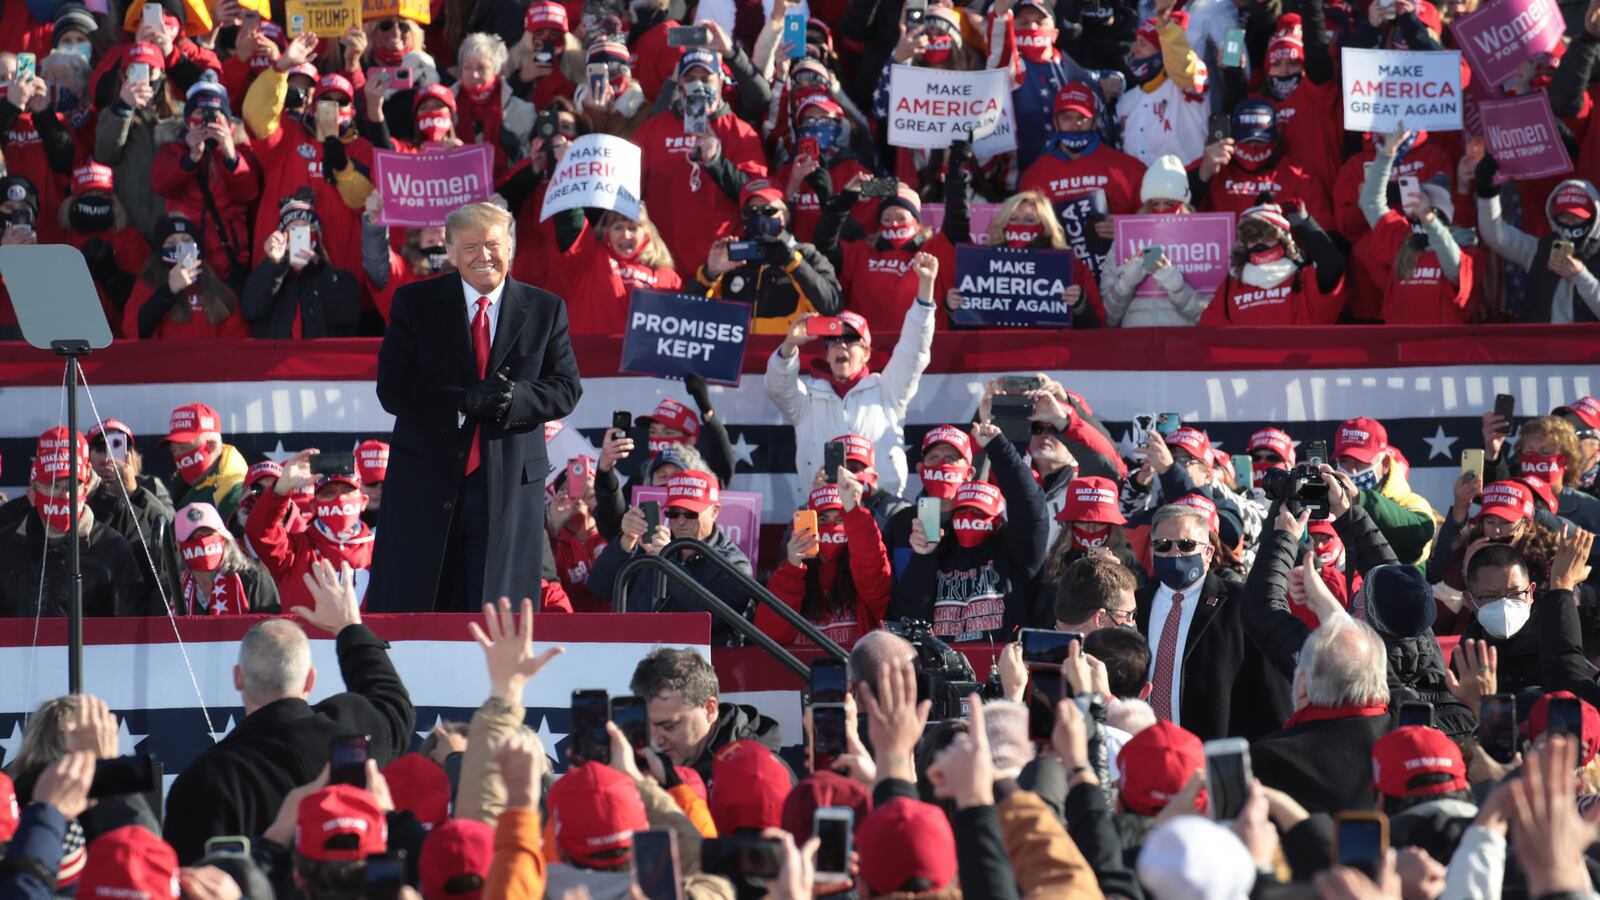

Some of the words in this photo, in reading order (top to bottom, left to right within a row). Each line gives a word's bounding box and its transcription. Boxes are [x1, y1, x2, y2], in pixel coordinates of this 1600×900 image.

[1473, 0, 1551, 55] Women
[925, 39, 951, 50] AGA
[1495, 43, 1520, 60] FOR
[1378, 65, 1423, 78] MAKE
[926, 83, 973, 97] MAKE
[1351, 80, 1456, 99] AMERICA
[896, 97, 998, 117] AMERICA
[1351, 101, 1399, 117] GREAT
[1405, 102, 1457, 117] AGAIN
[895, 118, 947, 134] GREAT
[951, 117, 996, 133] AGAIN
[8, 131, 39, 142] RUM
[665, 136, 698, 148] TRU
[1487, 122, 1549, 151] Women
[570, 147, 612, 161] MAKE
[1498, 150, 1516, 161] FOR
[1517, 144, 1547, 159] TRUMP
[386, 166, 479, 199] Women
[1050, 176, 1108, 191] TRUMP
[401, 195, 425, 206] FOR
[430, 193, 472, 207] TRUMP
[79, 203, 111, 216] TRUMP
[1129, 238, 1221, 262] Wmen
[868, 258, 915, 272] TRUM
[990, 260, 1036, 274] MAKE
[1177, 263, 1212, 273] RUMP
[960, 276, 1065, 296] AMERICA
[1233, 286, 1292, 305] TRUMP
[961, 298, 1012, 311] GREAT
[1015, 300, 1068, 314] AGAIN
[631, 312, 745, 344] PROMISES
[656, 338, 716, 361] KEPT
[1342, 428, 1370, 441] Trump
[924, 469, 963, 483] MAGA
[317, 503, 361, 517] MAGA
[953, 518, 993, 531] MAGA
[183, 543, 223, 561] MAGA
